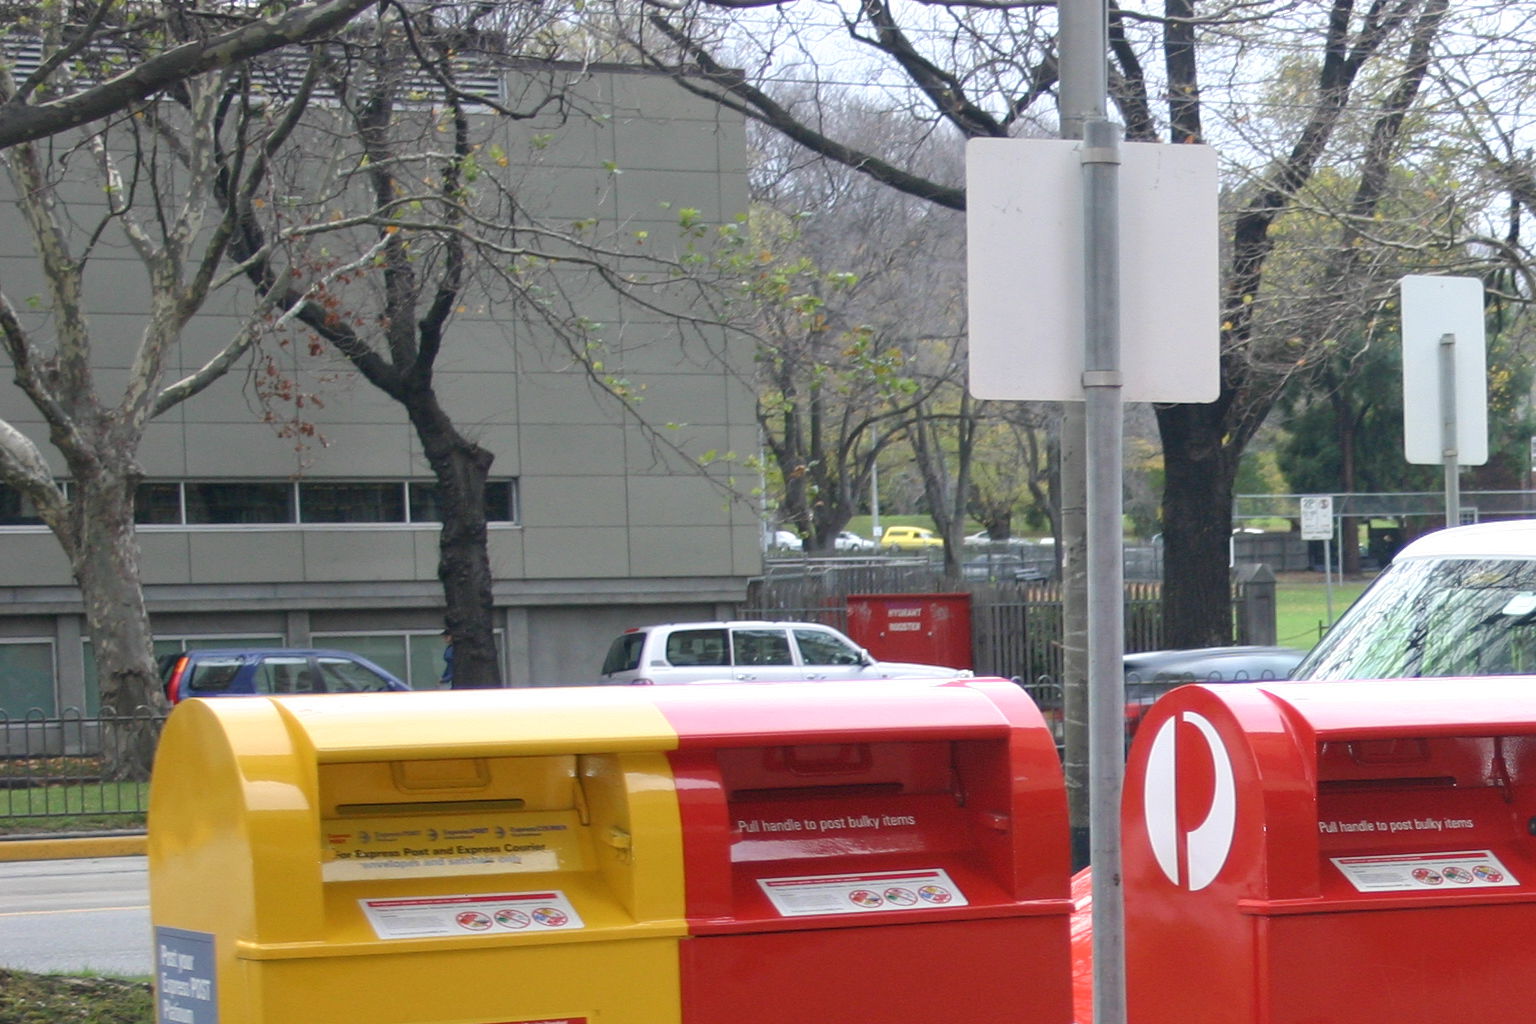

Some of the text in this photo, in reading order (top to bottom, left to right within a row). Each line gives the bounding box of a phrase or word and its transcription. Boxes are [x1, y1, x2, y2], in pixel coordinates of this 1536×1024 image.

[737, 814, 915, 833] Pull handle to post bulky items
[1318, 816, 1474, 833] Pull handle to post bulky items
[354, 849, 400, 860] Express
[403, 847, 429, 856] Post
[432, 846, 454, 855] and
[456, 844, 501, 855] Express
[503, 842, 546, 852] Courier
